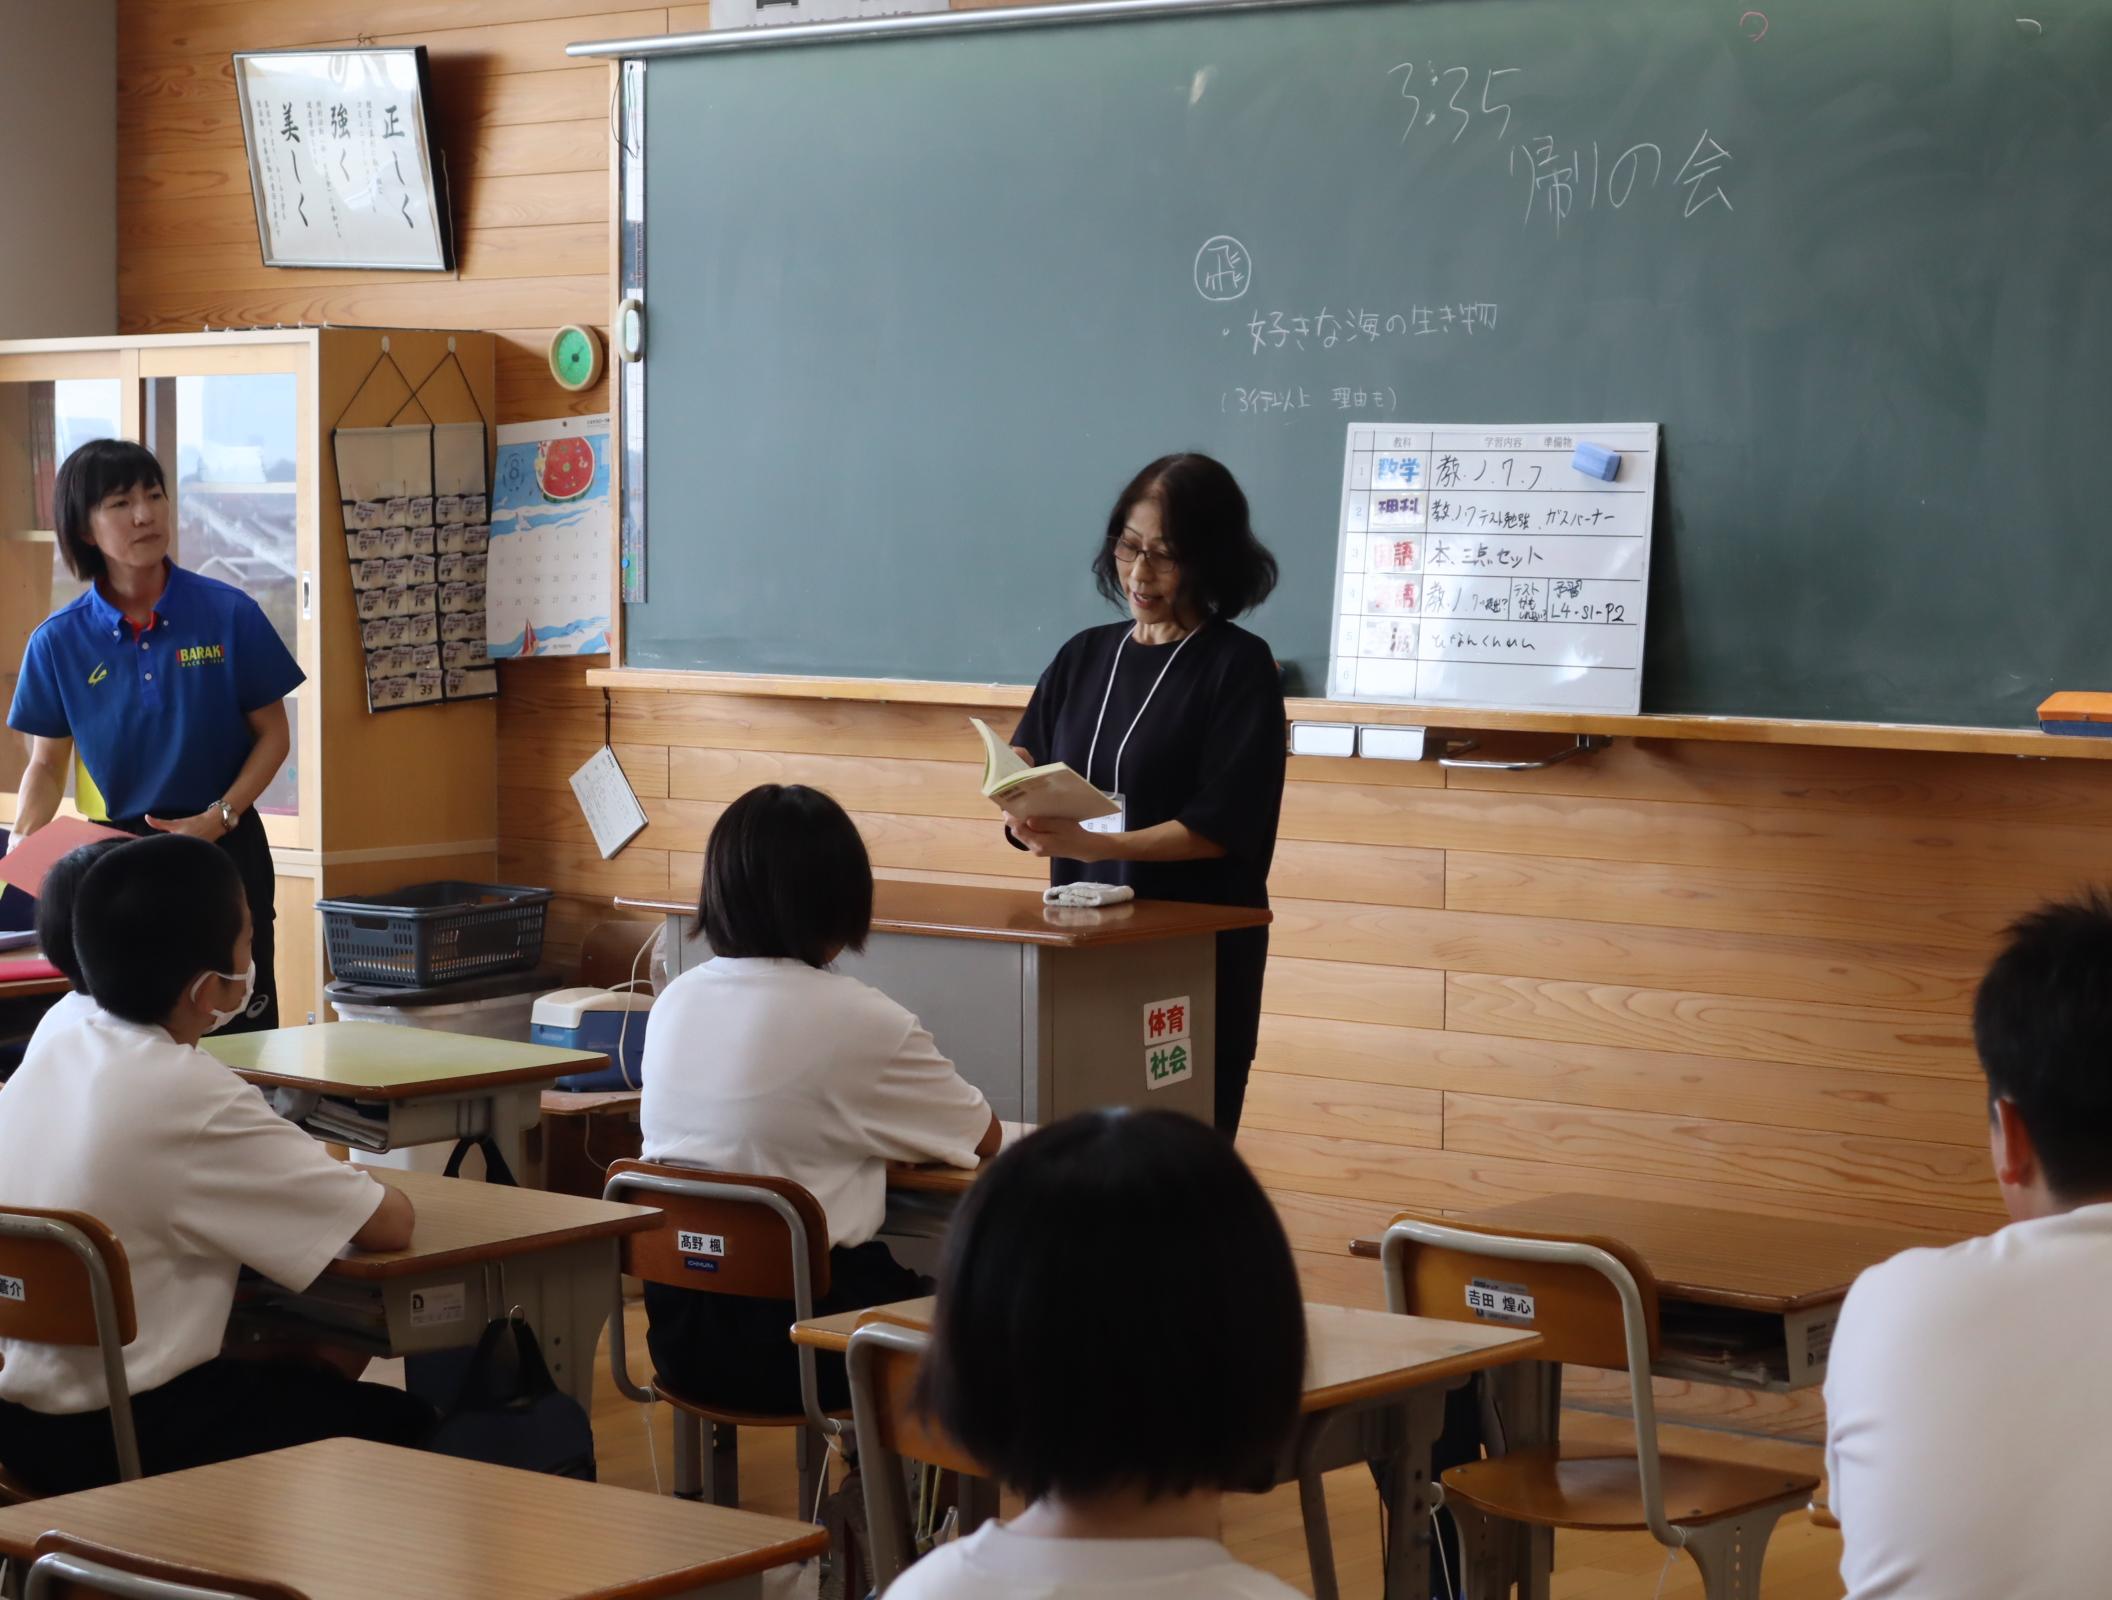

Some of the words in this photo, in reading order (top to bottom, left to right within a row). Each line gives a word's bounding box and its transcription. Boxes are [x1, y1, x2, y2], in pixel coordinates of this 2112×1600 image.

[1387, 59, 1522, 144] 3:35
[280, 101, 309, 227] 美しく
[330, 102, 351, 182] 強く
[382, 103, 414, 229] 正しく
[1509, 129, 1733, 237] 帰りの会
[1247, 302, 1498, 355] 好きな海の生き物
[1393, 437, 1411, 448] 教科
[1484, 436, 1523, 449] 学習内容
[1544, 436, 1573, 449] 準備物
[1377, 456, 1421, 483] 数学
[420, 684, 433, 696] 33
[1148, 1004, 1184, 1038] 体育
[1150, 1045, 1187, 1080] 社会
